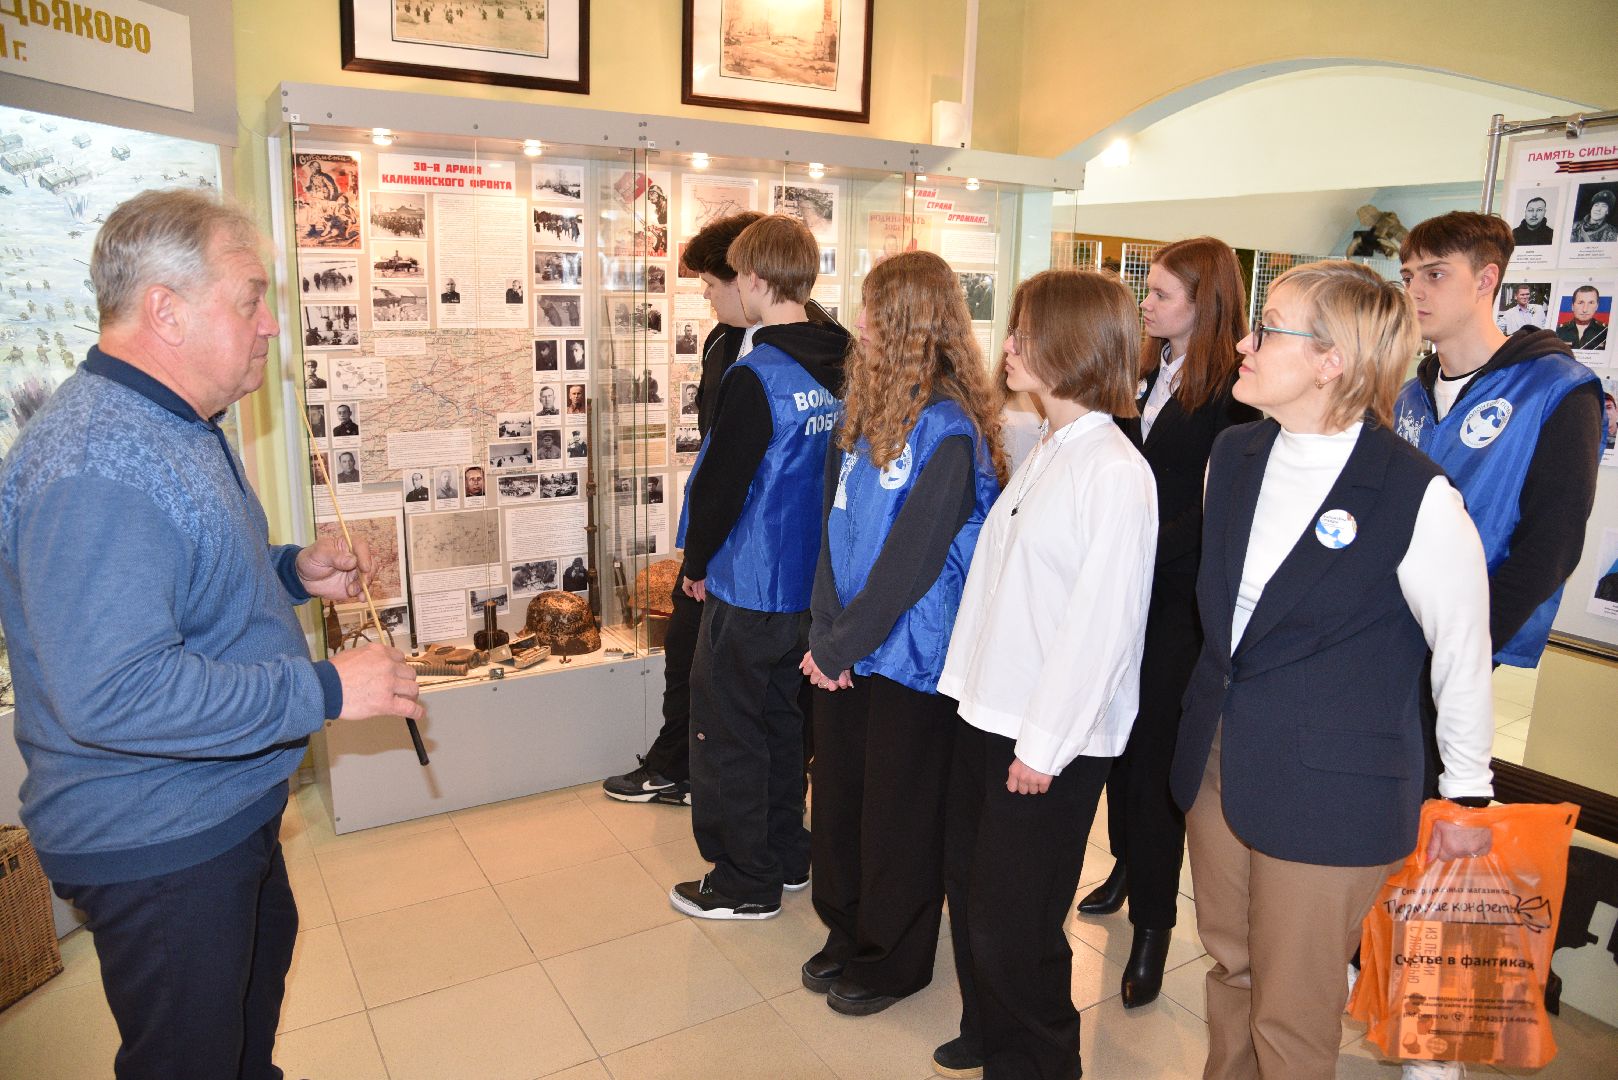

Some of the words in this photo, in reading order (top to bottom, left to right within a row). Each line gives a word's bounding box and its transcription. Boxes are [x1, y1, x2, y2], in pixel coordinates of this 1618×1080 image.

[1528, 149, 1575, 162] ПАМЯТЬ
[445, 164, 483, 175] АРМИЯ
[382, 174, 465, 188] КАЛИНИНСКОГО
[469, 179, 513, 191] ФРОНТА
[926, 200, 953, 211] СТРАНА
[792, 387, 839, 411] ВОЛО
[1447, 957, 1456, 966] в
[1460, 954, 1535, 971] фантиках
